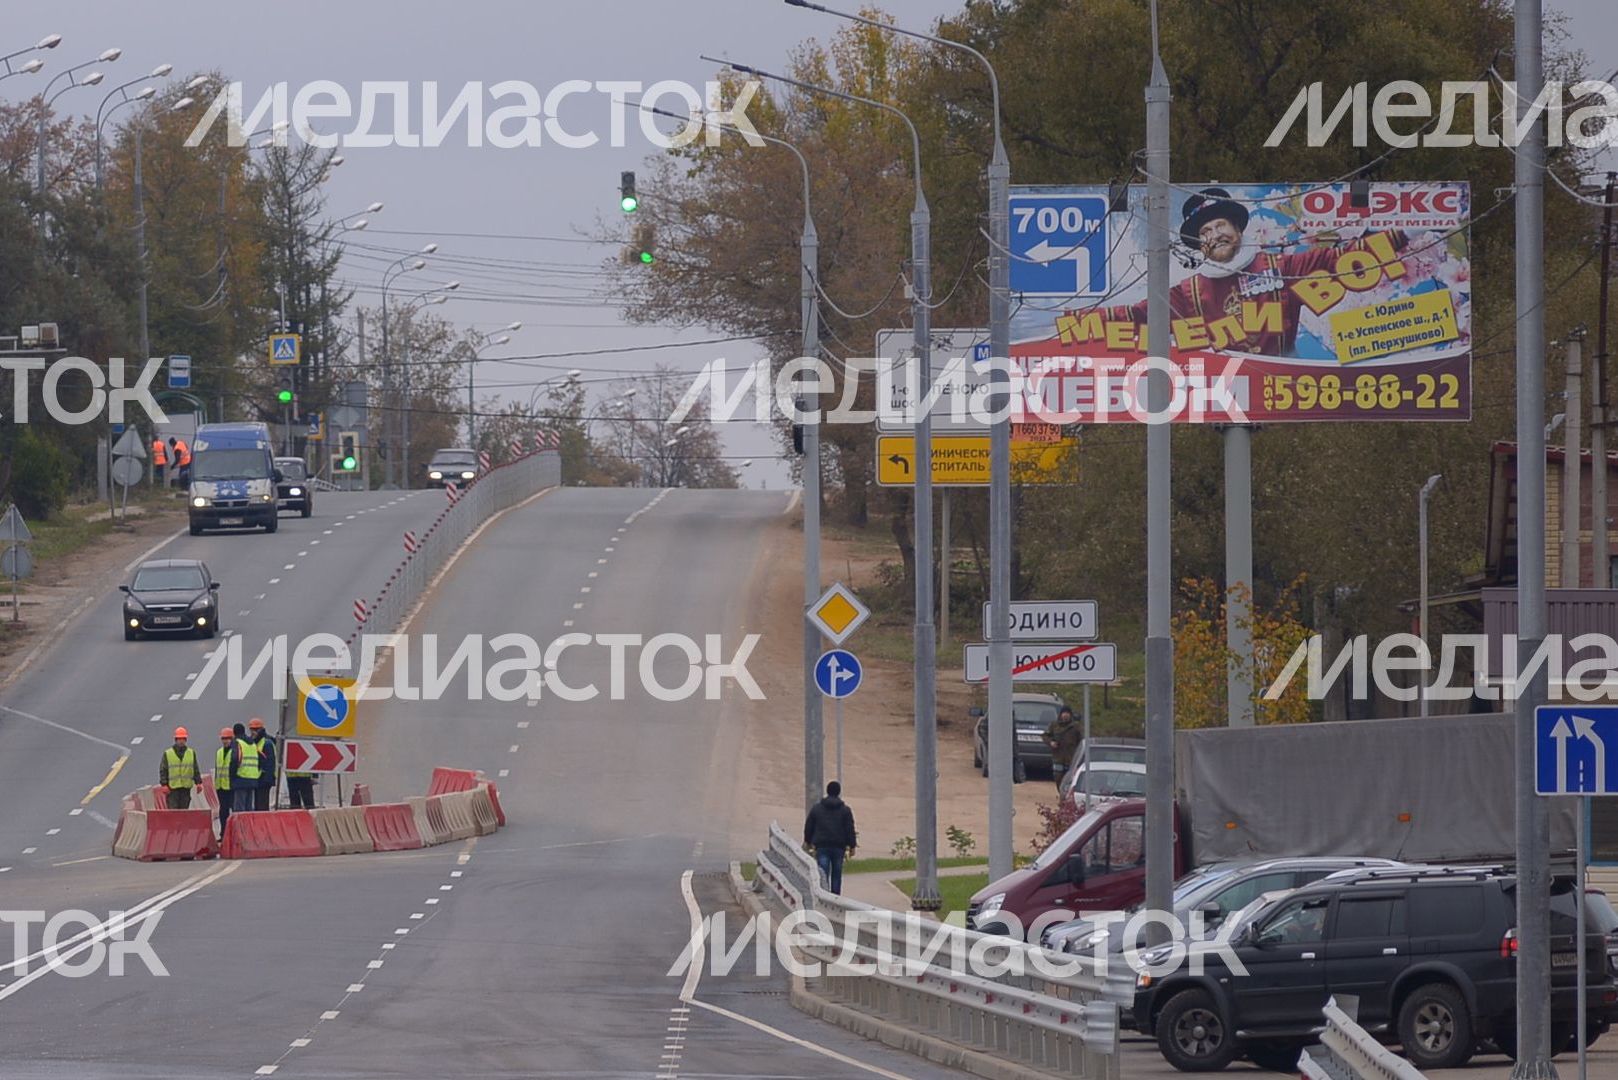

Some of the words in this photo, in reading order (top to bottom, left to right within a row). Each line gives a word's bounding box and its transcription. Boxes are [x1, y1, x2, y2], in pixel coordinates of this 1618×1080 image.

[1303, 191, 1458, 218] ОДЭКС
[1303, 219, 1327, 227] НА
[1370, 219, 1457, 227] ВРЕМЕНА
[1375, 300, 1415, 317] Юдино
[1055, 301, 1283, 351] МЕЕЛИ
[1355, 319, 1412, 338] Успенское
[1348, 344, 1371, 358] (пл.
[1371, 325, 1445, 352] Перхушково)
[1010, 356, 1093, 376] ЦЕНТР
[1100, 363, 1204, 372] www.odexter.com
[932, 383, 990, 395] ПЕНСКО
[1263, 375, 1274, 411] 495
[1274, 373, 1460, 410] 598-88-22
[930, 448, 990, 459] ИНИЧЕСКИ
[931, 461, 986, 472] СПИТАЛЬ
[985, 654, 1096, 673] ЮКОВО
